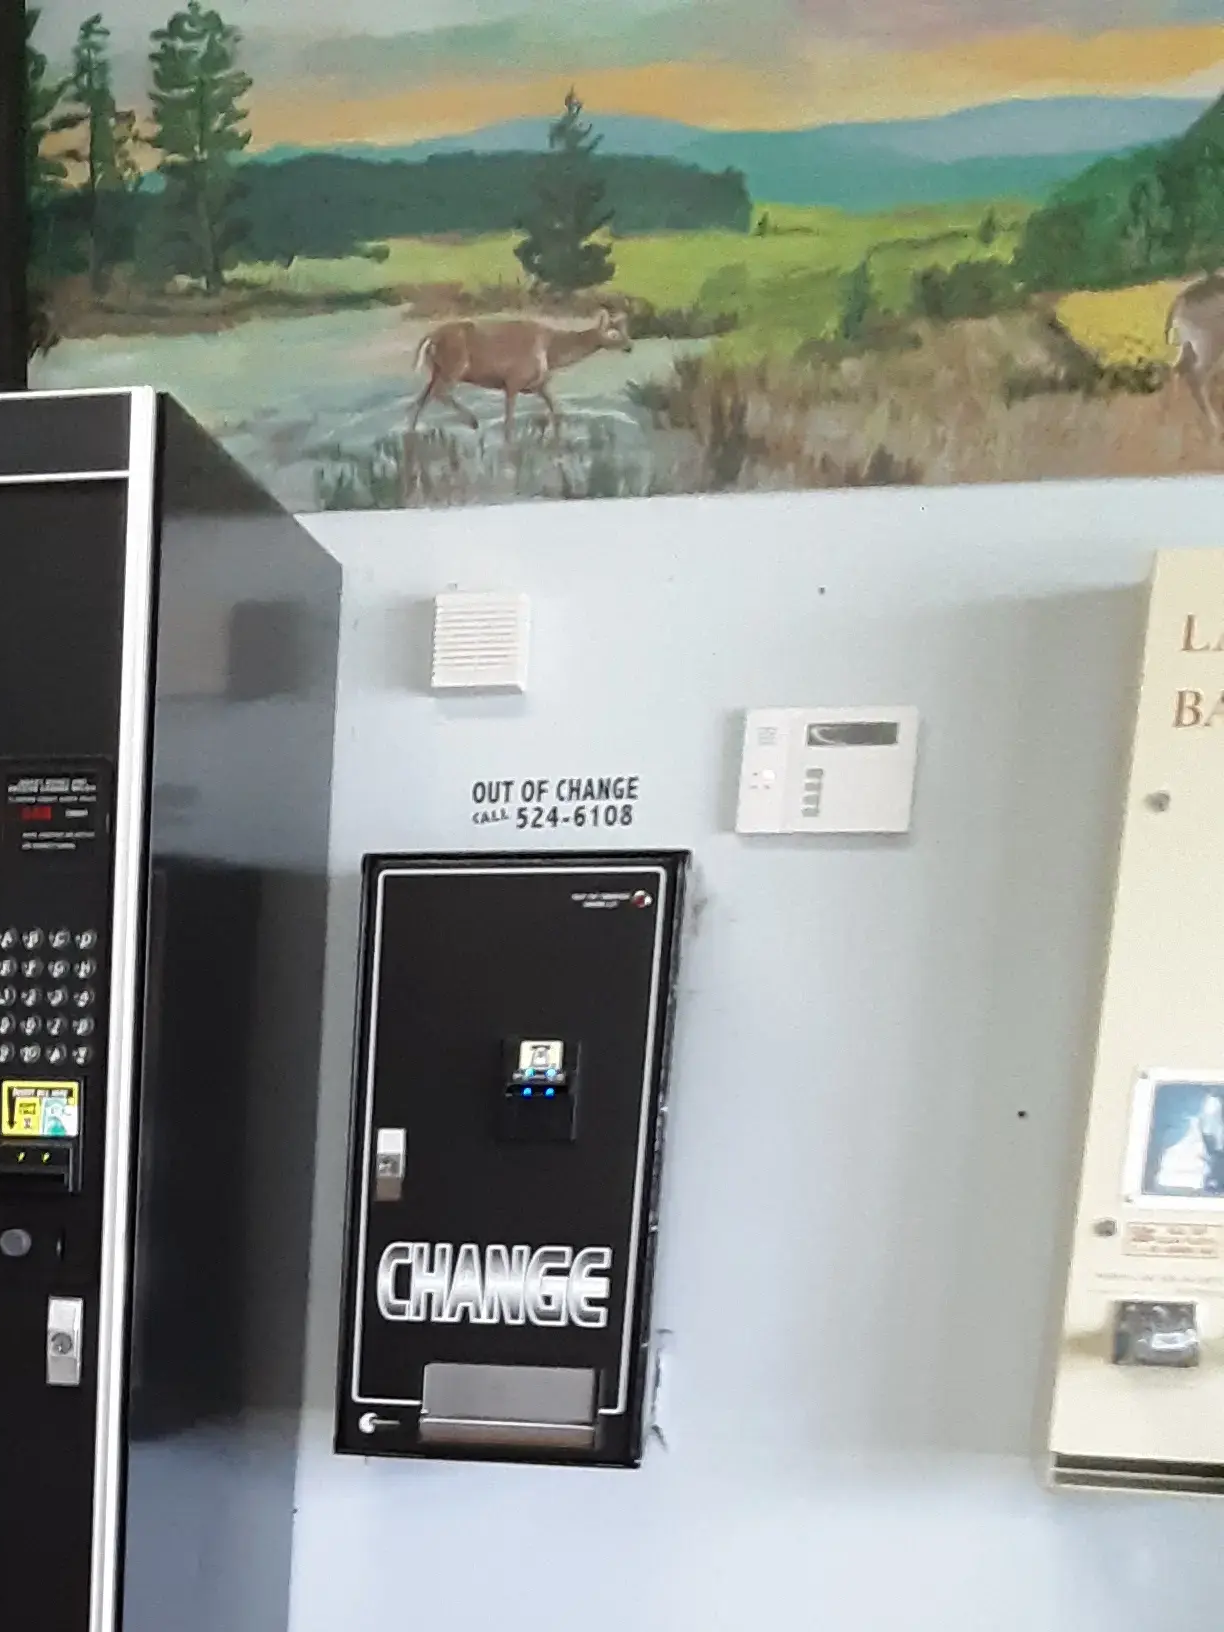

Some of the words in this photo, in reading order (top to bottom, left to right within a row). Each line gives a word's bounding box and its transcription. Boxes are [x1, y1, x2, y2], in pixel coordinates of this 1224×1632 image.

[472, 779, 514, 804] OUT
[521, 778, 549, 803] OF
[555, 775, 640, 802] CHANGE
[472, 807, 509, 825] CALL
[516, 803, 634, 829] 524-6108
[377, 1241, 612, 1329] CHANGE
